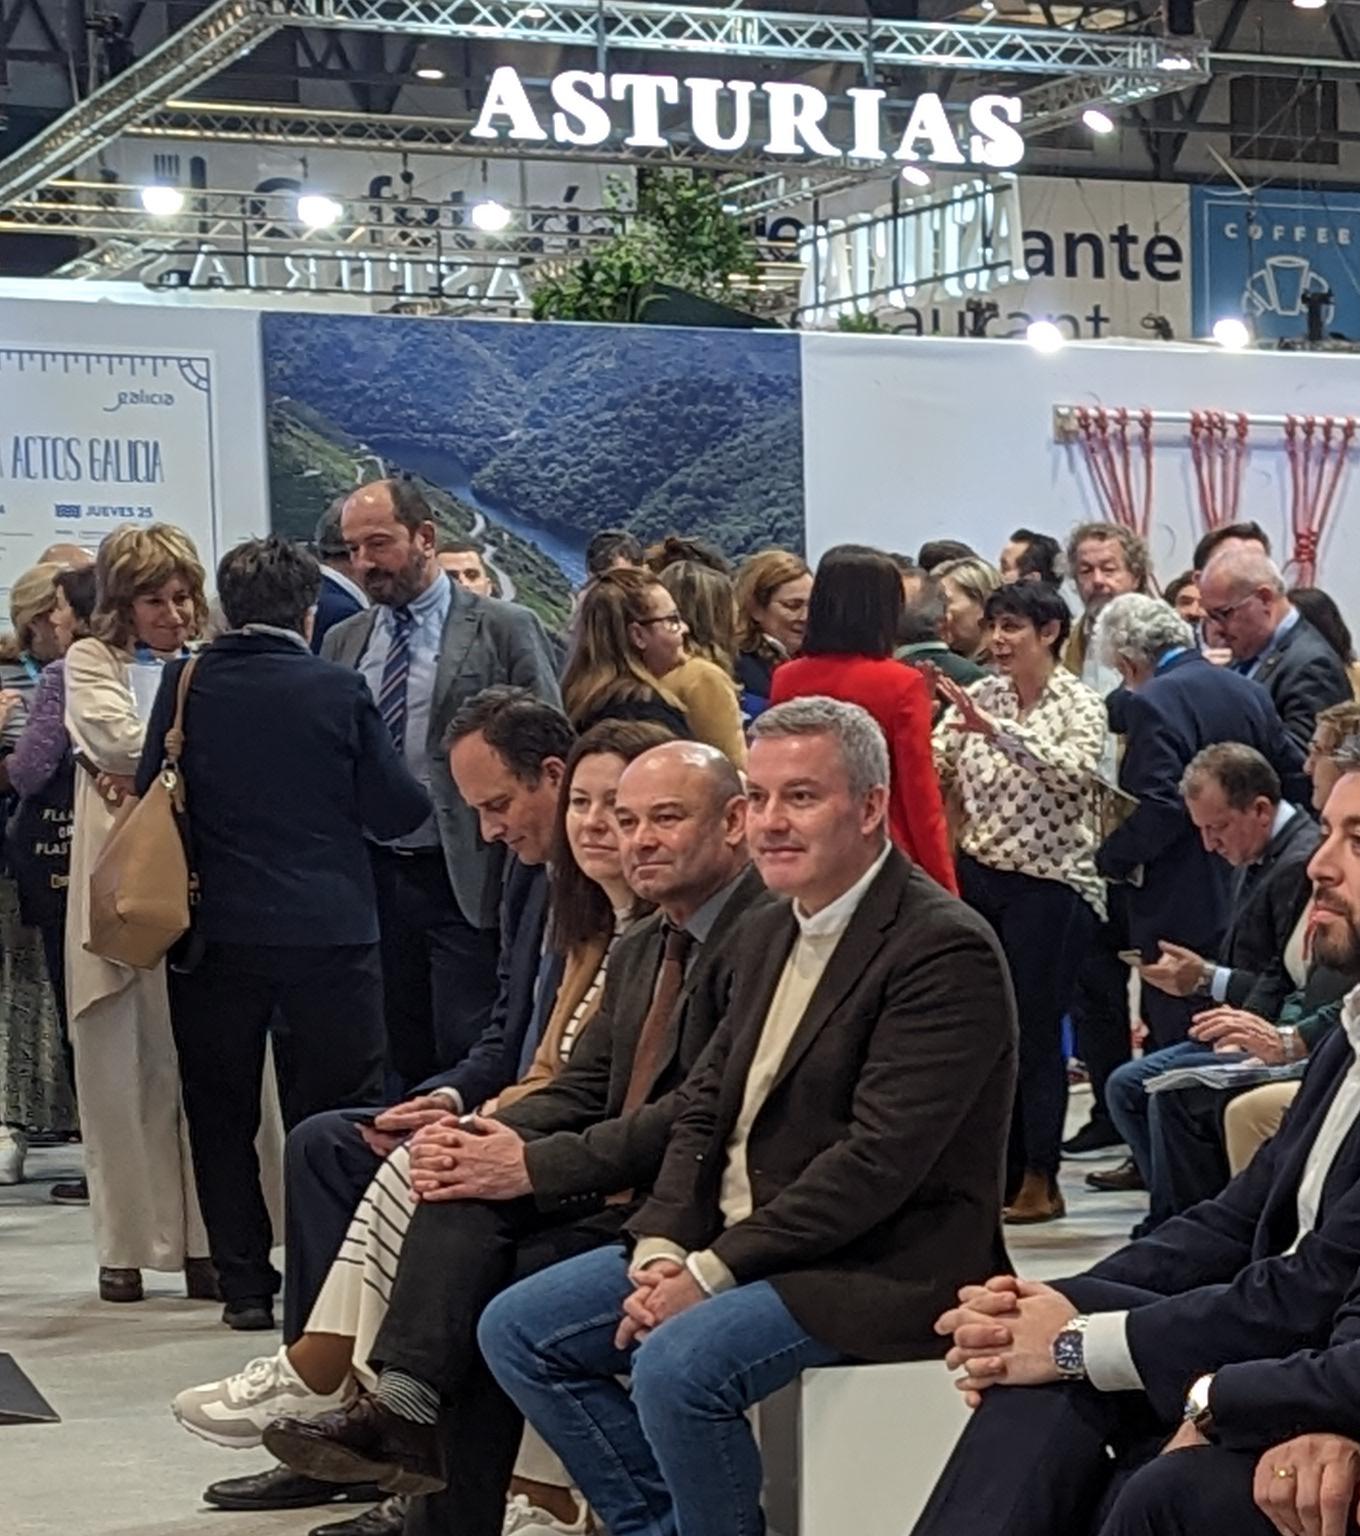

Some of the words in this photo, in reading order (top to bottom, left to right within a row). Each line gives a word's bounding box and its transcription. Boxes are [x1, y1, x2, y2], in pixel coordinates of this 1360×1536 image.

[470, 66, 1026, 168] ASTURIAS
[1012, 222, 1183, 282] ante
[1224, 223, 1350, 245] COFFEE
[11, 436, 82, 481] ACTOS
[89, 438, 165, 483] GALICIA
[86, 506, 134, 517] JUEVES
